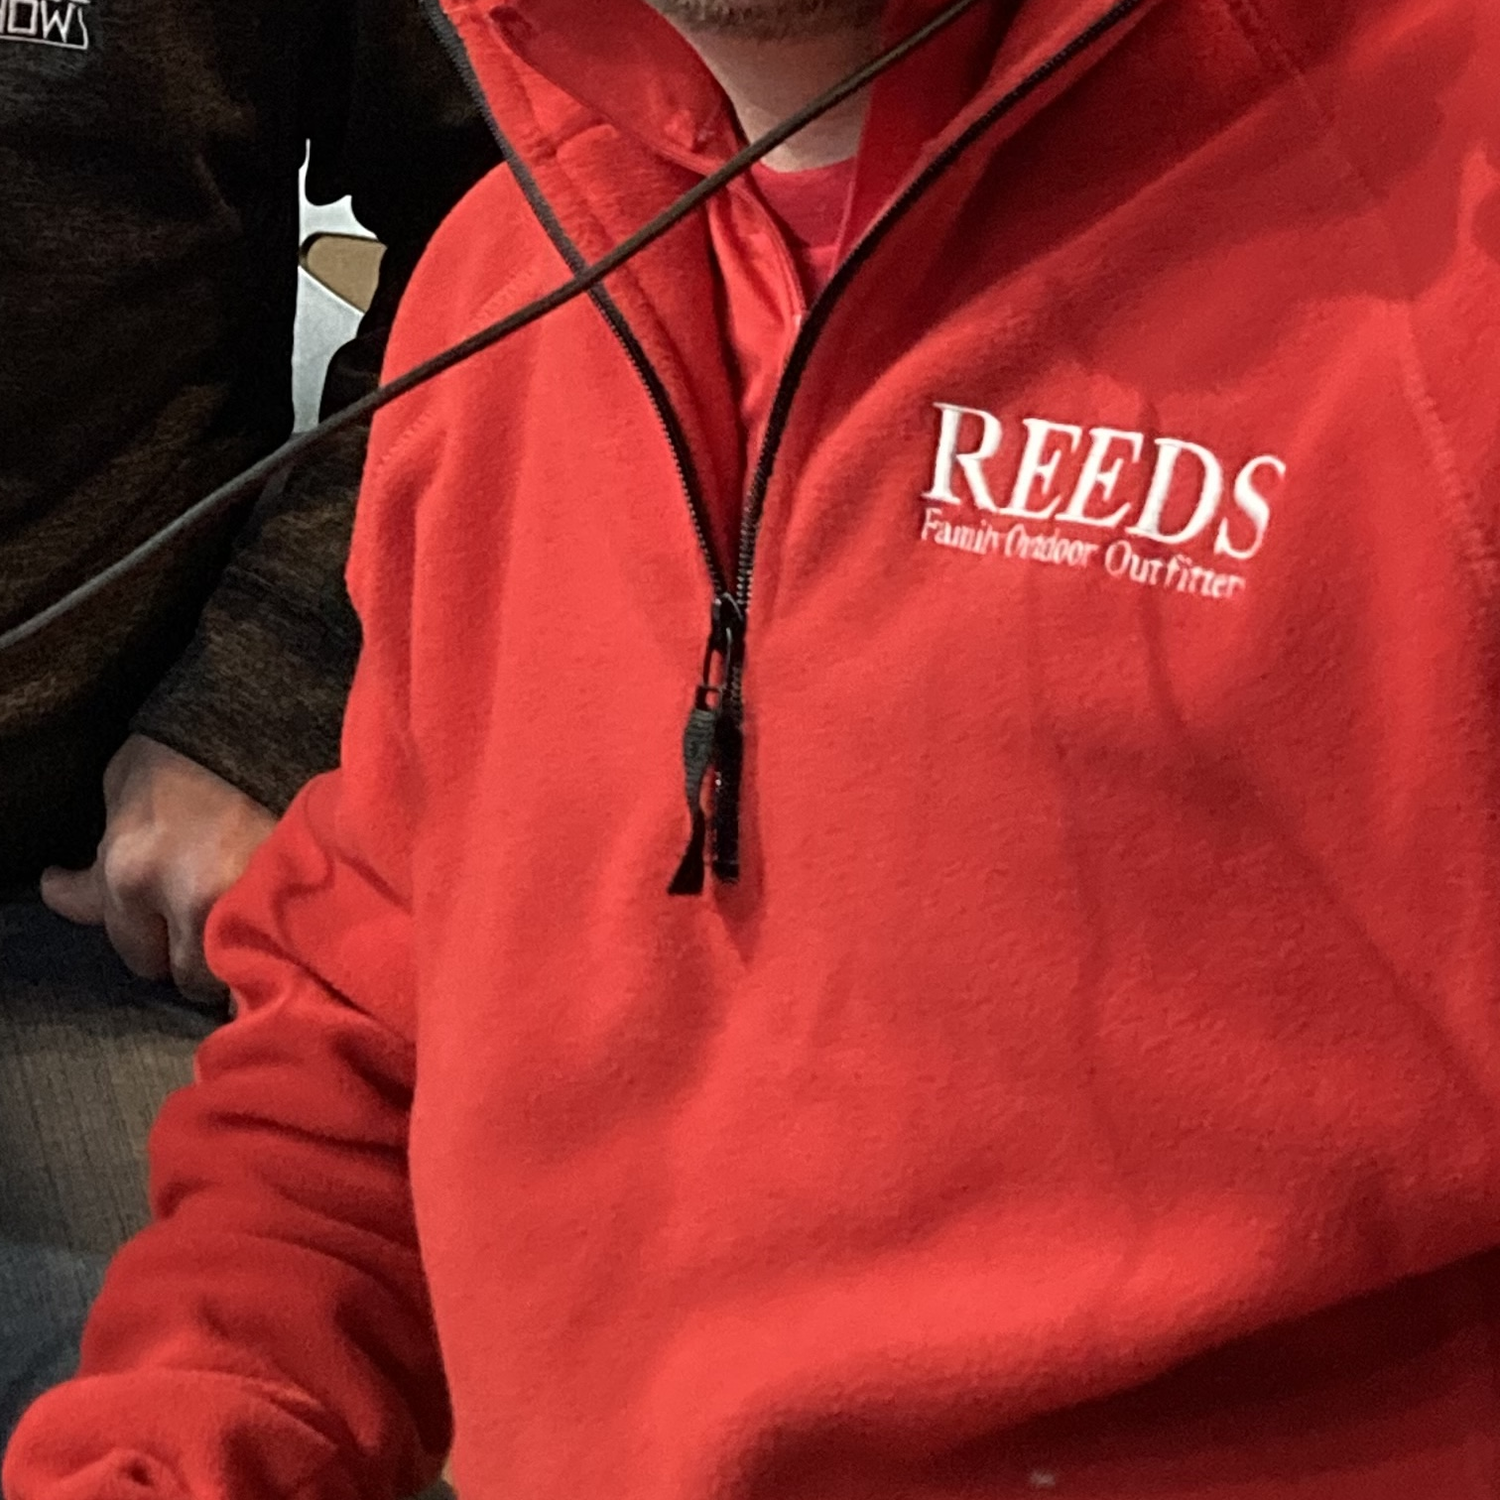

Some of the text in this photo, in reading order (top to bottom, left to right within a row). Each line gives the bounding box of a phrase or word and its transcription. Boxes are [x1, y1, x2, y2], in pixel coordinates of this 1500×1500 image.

[920, 401, 1287, 560] REEDS
[920, 506, 1000, 556] Family
[1003, 522, 1101, 568] Outdoor
